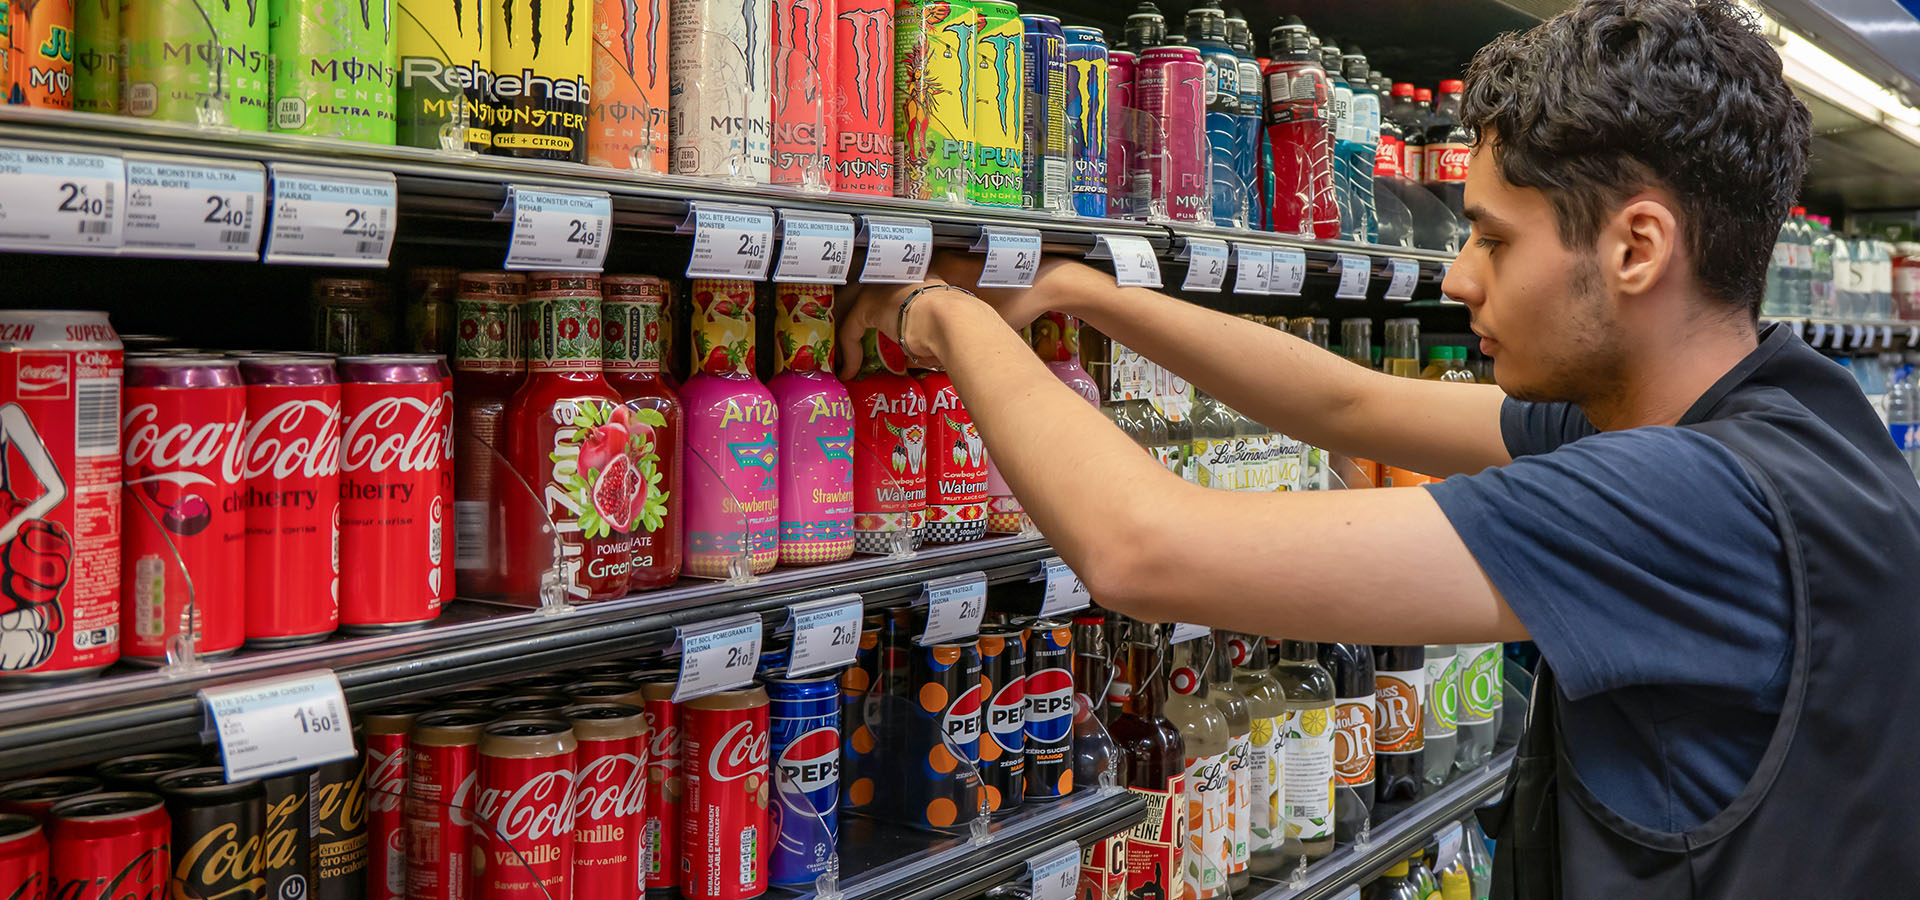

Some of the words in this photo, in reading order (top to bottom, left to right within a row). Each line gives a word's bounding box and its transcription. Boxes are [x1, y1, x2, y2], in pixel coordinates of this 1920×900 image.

[29, 66, 73, 97] MO
[281, 102, 299, 112] ZERO
[318, 105, 370, 117] ULTRA
[280, 114, 301, 125] SUGAR
[498, 134, 516, 144] THÉ
[532, 138, 571, 148] CITRON
[681, 151, 694, 160] ZERO
[680, 160, 696, 169] SUGAR
[157, 167, 204, 179] MONSTER
[206, 172, 236, 182] ULTRA
[131, 178, 159, 187] ROSA
[837, 182, 875, 190] UNCH
[279, 190, 312, 201] PARADI
[320, 184, 360, 195] MONSTER
[362, 187, 389, 198] ULTRA
[518, 194, 535, 203] 50CL
[536, 196, 569, 206] MONSTER
[569, 200, 593, 209] CITRON
[204, 194, 243, 227] 2€40
[518, 203, 542, 213] REHAB
[724, 215, 746, 223] PEACHY
[698, 221, 725, 230] MONSTER
[798, 222, 809, 230] 50CL
[810, 223, 833, 231] MONSTER
[891, 227, 913, 235] MONSTER
[567, 218, 595, 246] 2€49
[786, 229, 801, 237] ZERO
[737, 233, 760, 257] 2€40
[821, 240, 842, 263] 2€46
[901, 243, 921, 264] 2€40
[943, 471, 975, 480] Cowboy
[631, 549, 653, 568] ea
[952, 585, 974, 593] PASTEQUE
[959, 600, 976, 619] 2€10
[813, 612, 834, 620] ARIZONA
[797, 623, 815, 631] FRAISE
[686, 638, 697, 647] PET
[712, 626, 753, 640] POMEGRANATE
[831, 625, 851, 646] 2€10
[686, 644, 711, 654] ARIZONA
[725, 646, 749, 668] 2€10
[294, 706, 331, 733] 1€50
[1026, 747, 1045, 755] ZÉRO
[1037, 752, 1063, 760] MANGO
[494, 844, 561, 867] vanille
[597, 855, 628, 865] vanille
[713, 846, 721, 896] RECYCLABLE
[494, 880, 529, 890] Saveur
